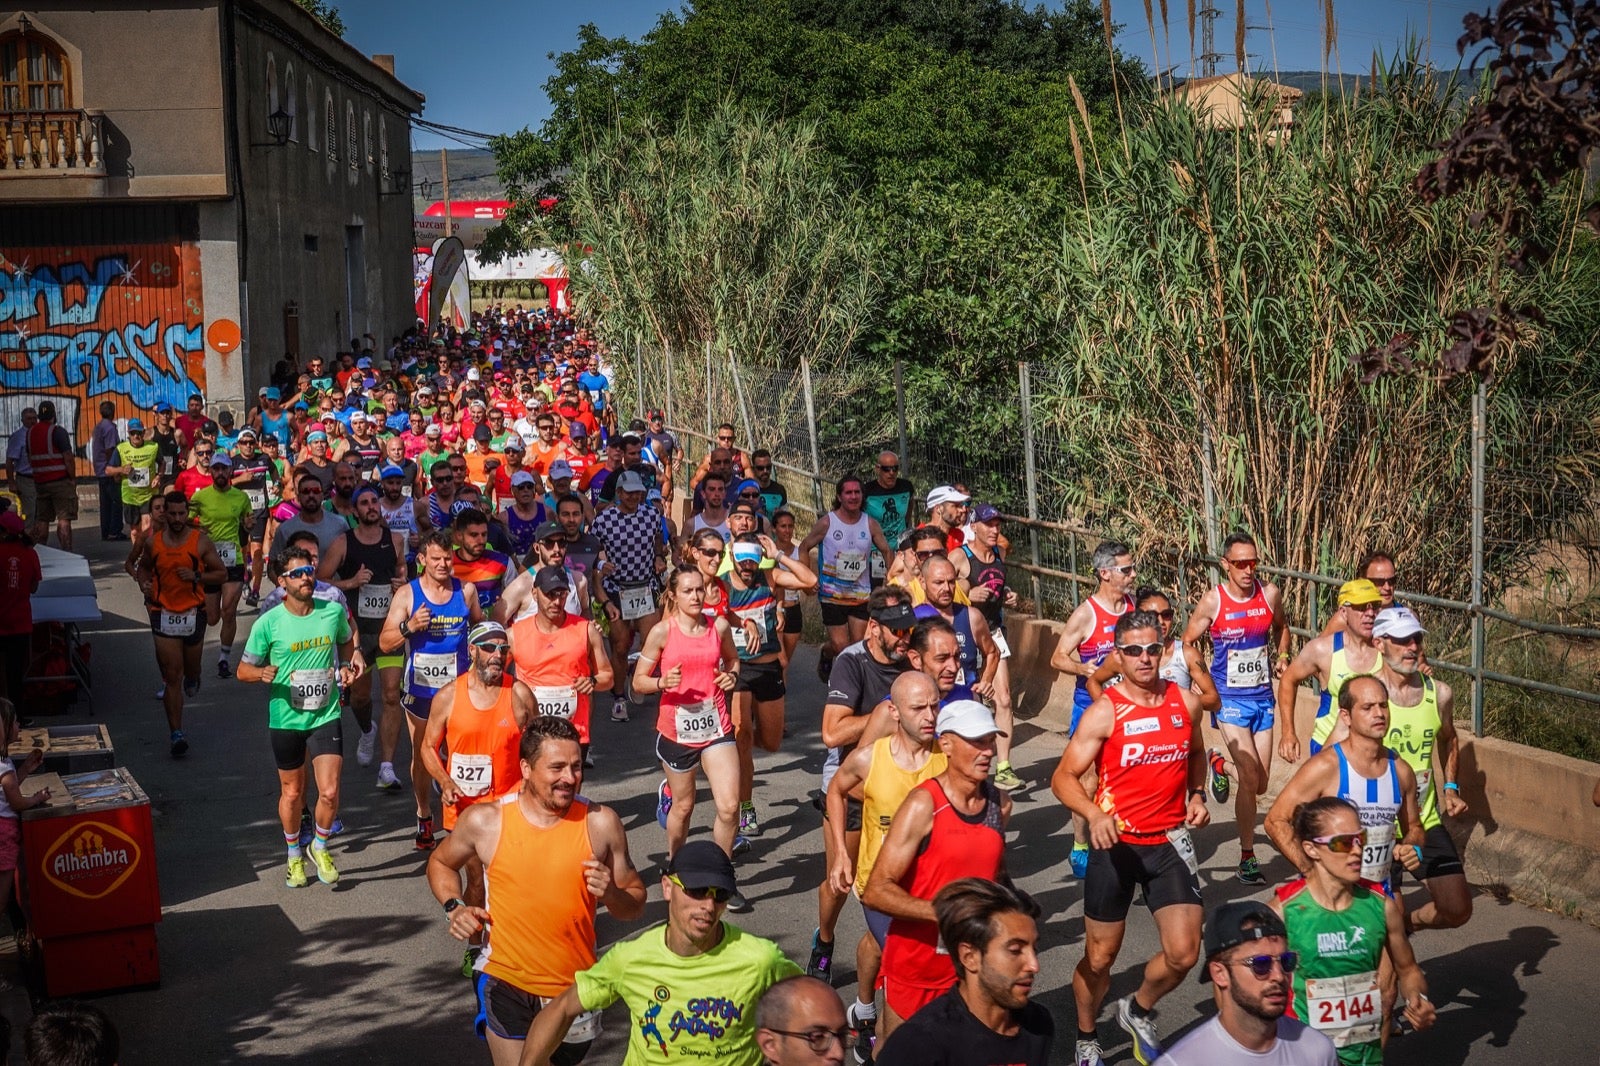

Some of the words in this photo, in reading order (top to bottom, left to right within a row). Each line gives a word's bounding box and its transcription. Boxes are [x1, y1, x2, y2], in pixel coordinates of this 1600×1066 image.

[843, 560, 860, 570] 740
[364, 596, 389, 608] 3032
[628, 597, 647, 609] 174
[1246, 607, 1267, 617] SEUR
[168, 615, 188, 625] 561
[423, 665, 449, 677] 304
[1237, 660, 1262, 674] 666
[298, 683, 328, 698] 3066
[538, 701, 570, 716] 3024
[683, 714, 714, 732] 3036
[456, 765, 485, 781] 327
[1364, 844, 1390, 864] 377
[54, 847, 129, 876] Alhambra
[1318, 993, 1374, 1023] 2144
